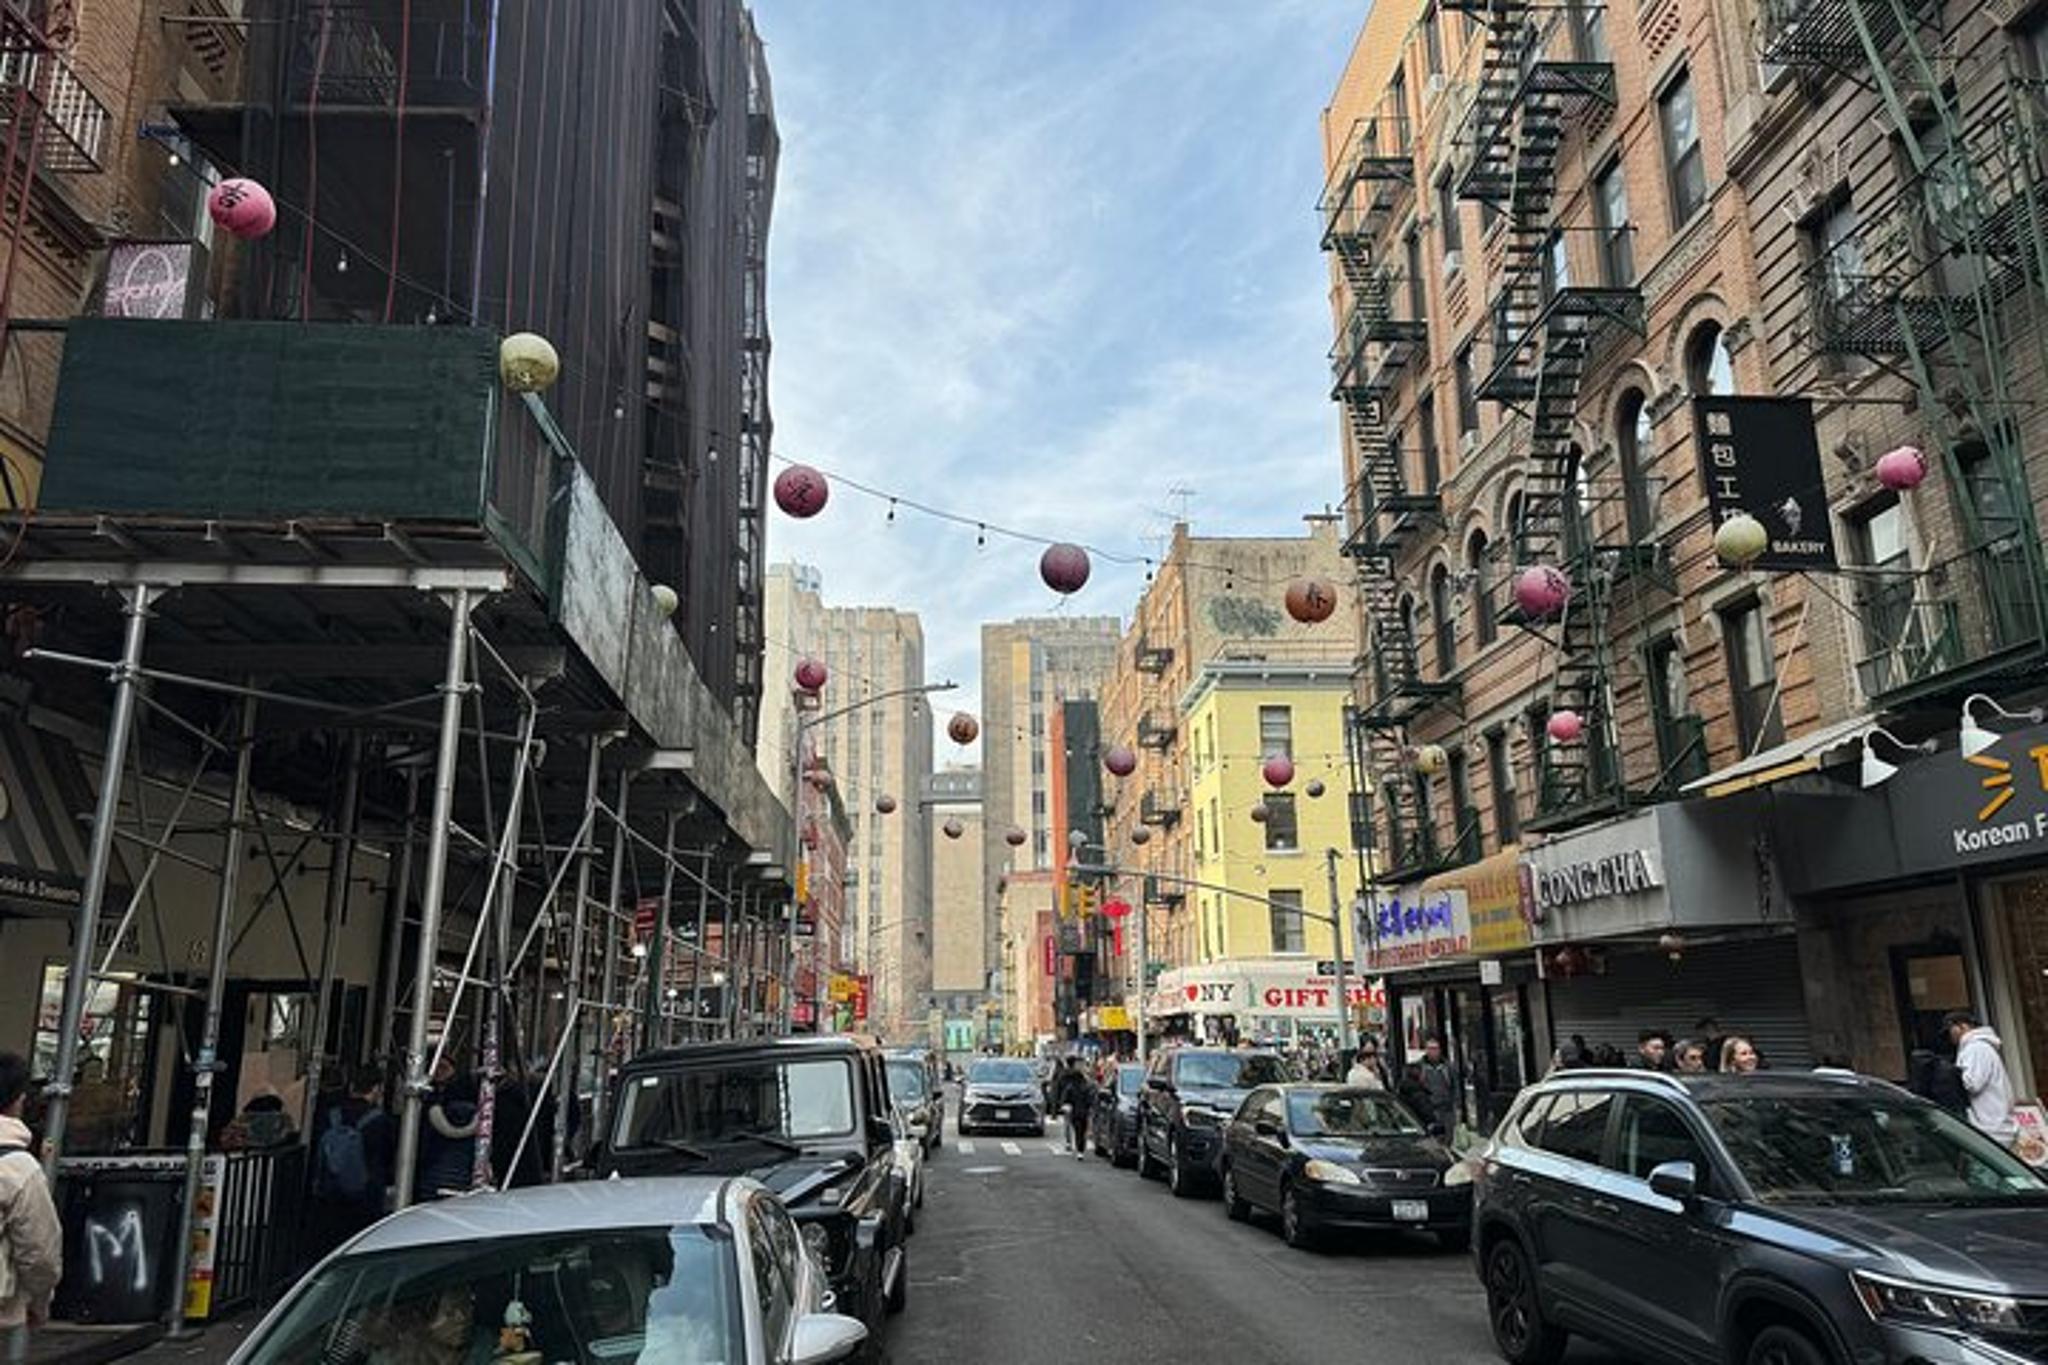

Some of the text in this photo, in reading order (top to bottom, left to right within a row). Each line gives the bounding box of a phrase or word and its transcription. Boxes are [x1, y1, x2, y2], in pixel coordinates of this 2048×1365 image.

[1772, 541, 1826, 554] BAKERY
[1954, 822, 2029, 852] Korean
[1201, 983, 1235, 1003] NY
[1265, 988, 1328, 1007] GIFT
